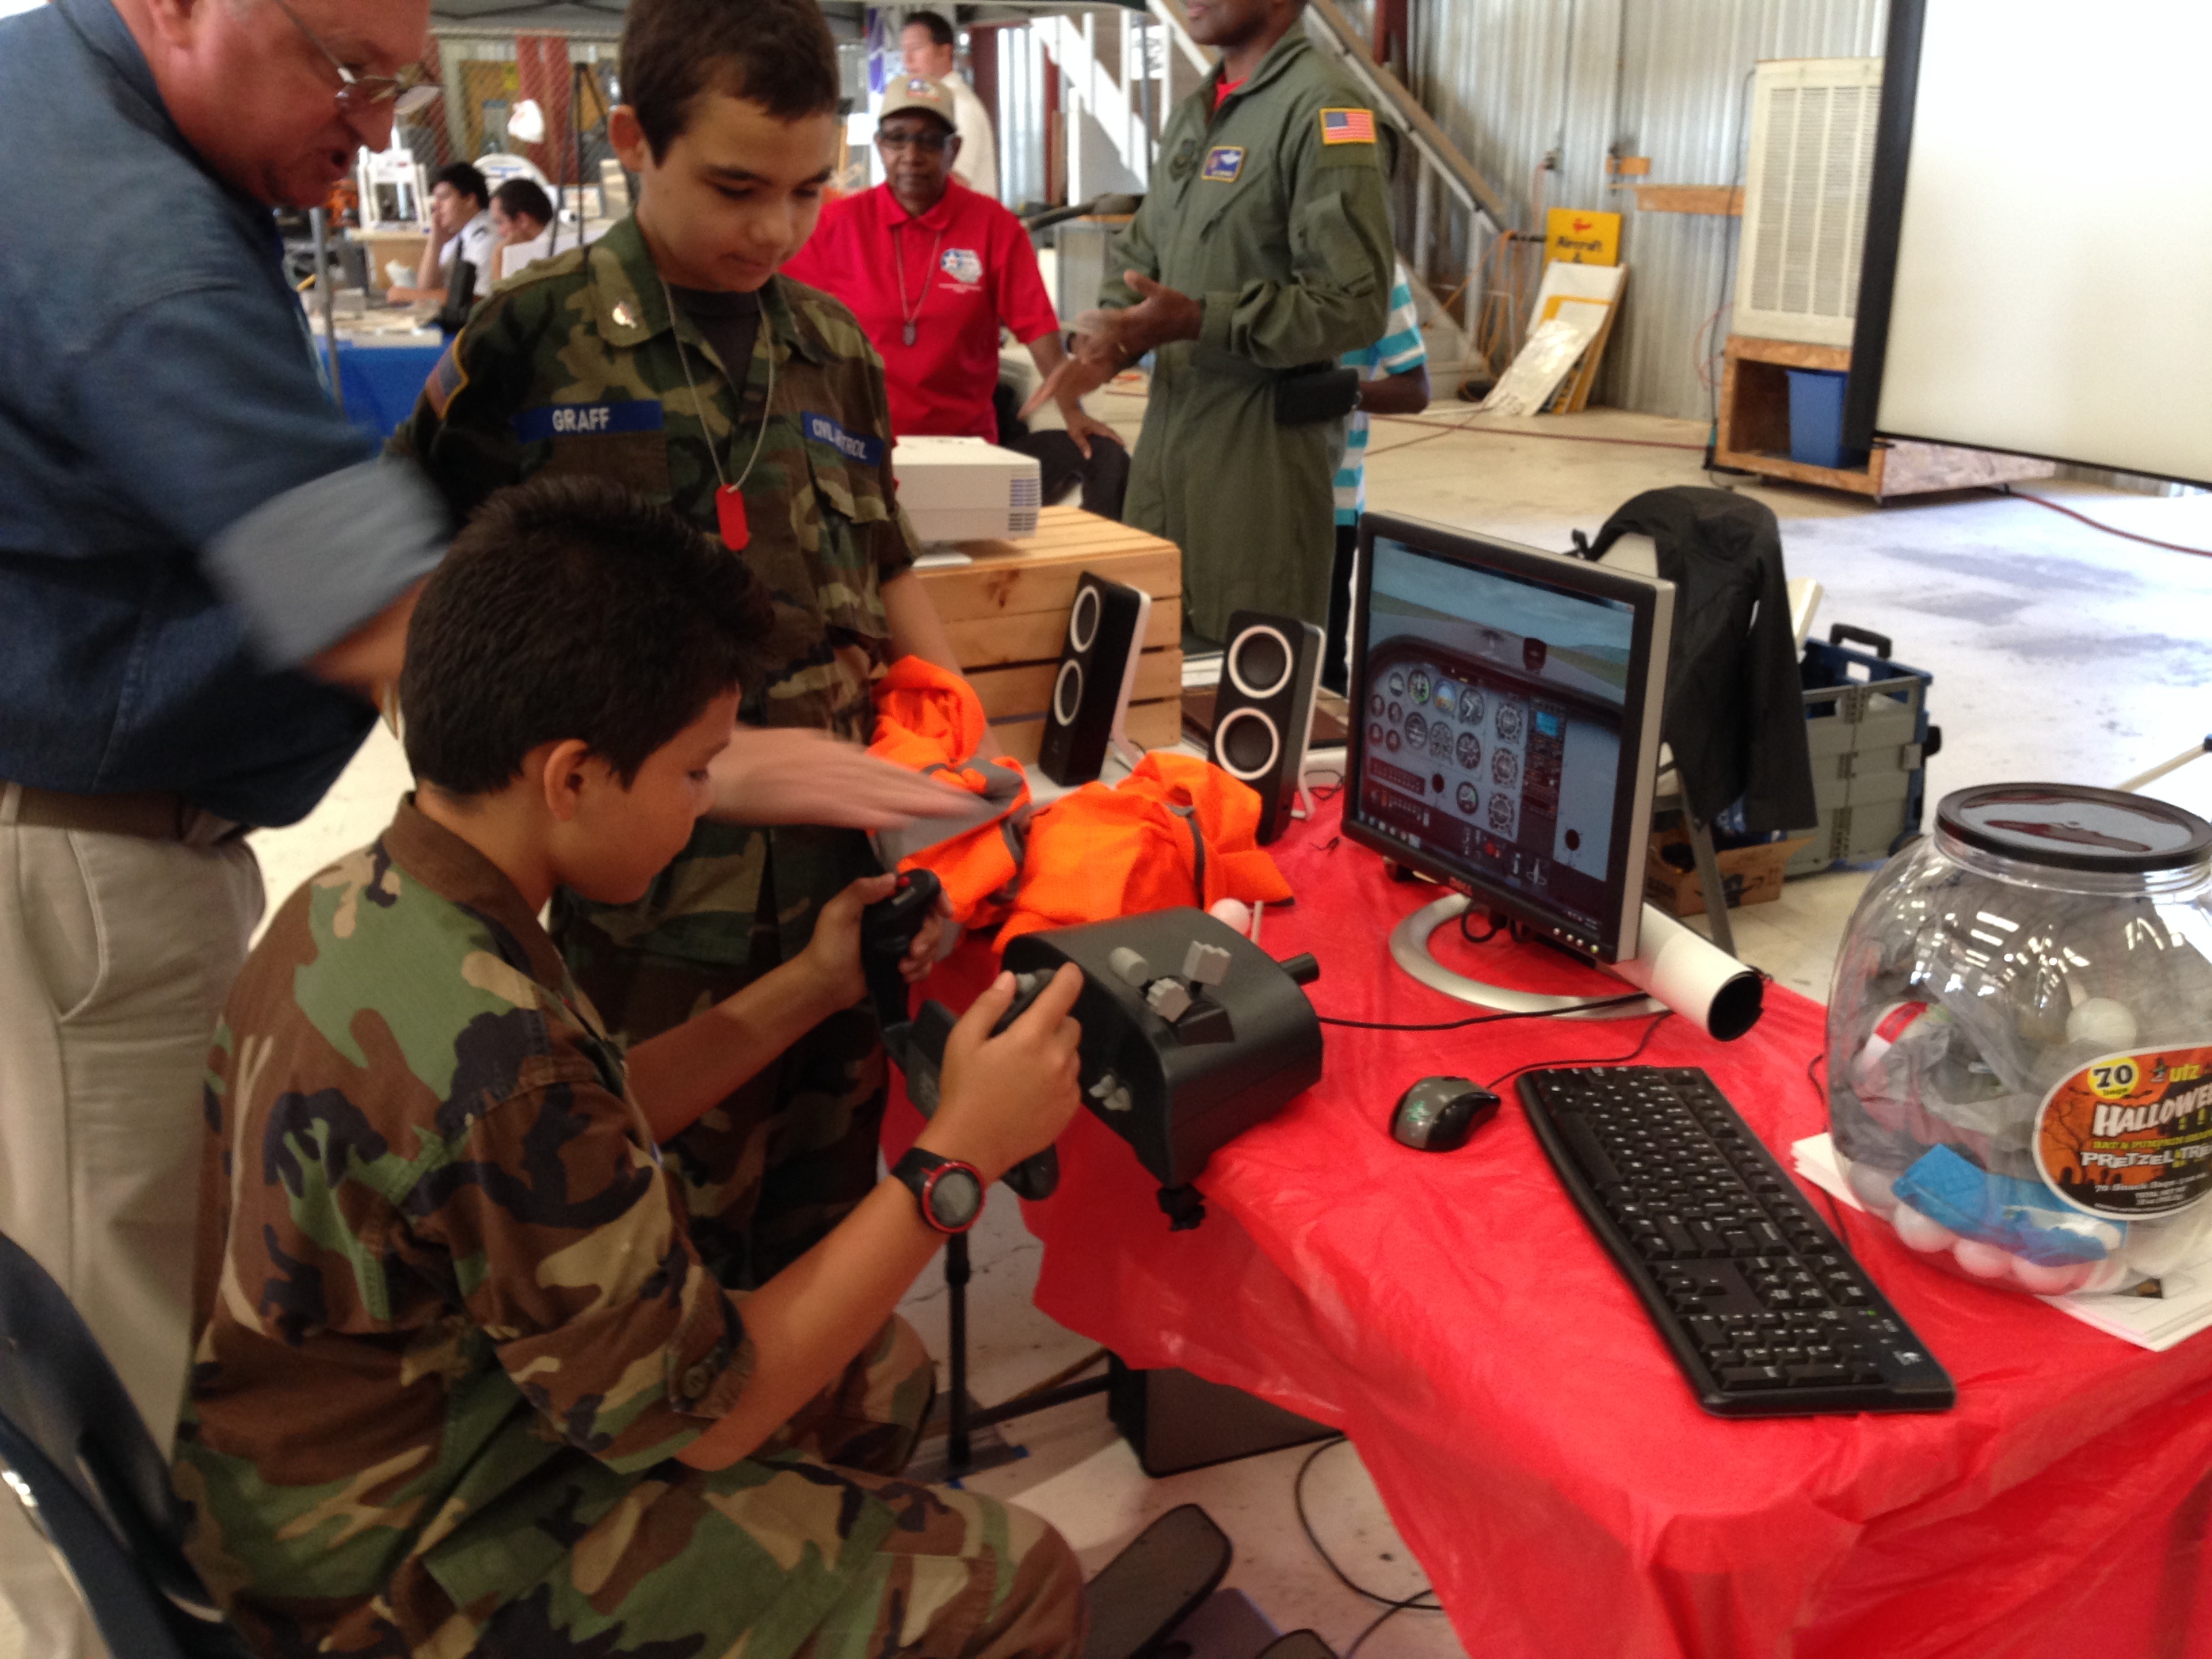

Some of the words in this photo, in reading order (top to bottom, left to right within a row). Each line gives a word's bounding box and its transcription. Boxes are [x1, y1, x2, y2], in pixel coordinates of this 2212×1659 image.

[552, 407, 610, 432] GRAFF
[2093, 1064, 2133, 1088] 70
[2092, 1082, 2212, 1137] HALLOWE
[2080, 1150, 2175, 1169] PRETZEL
